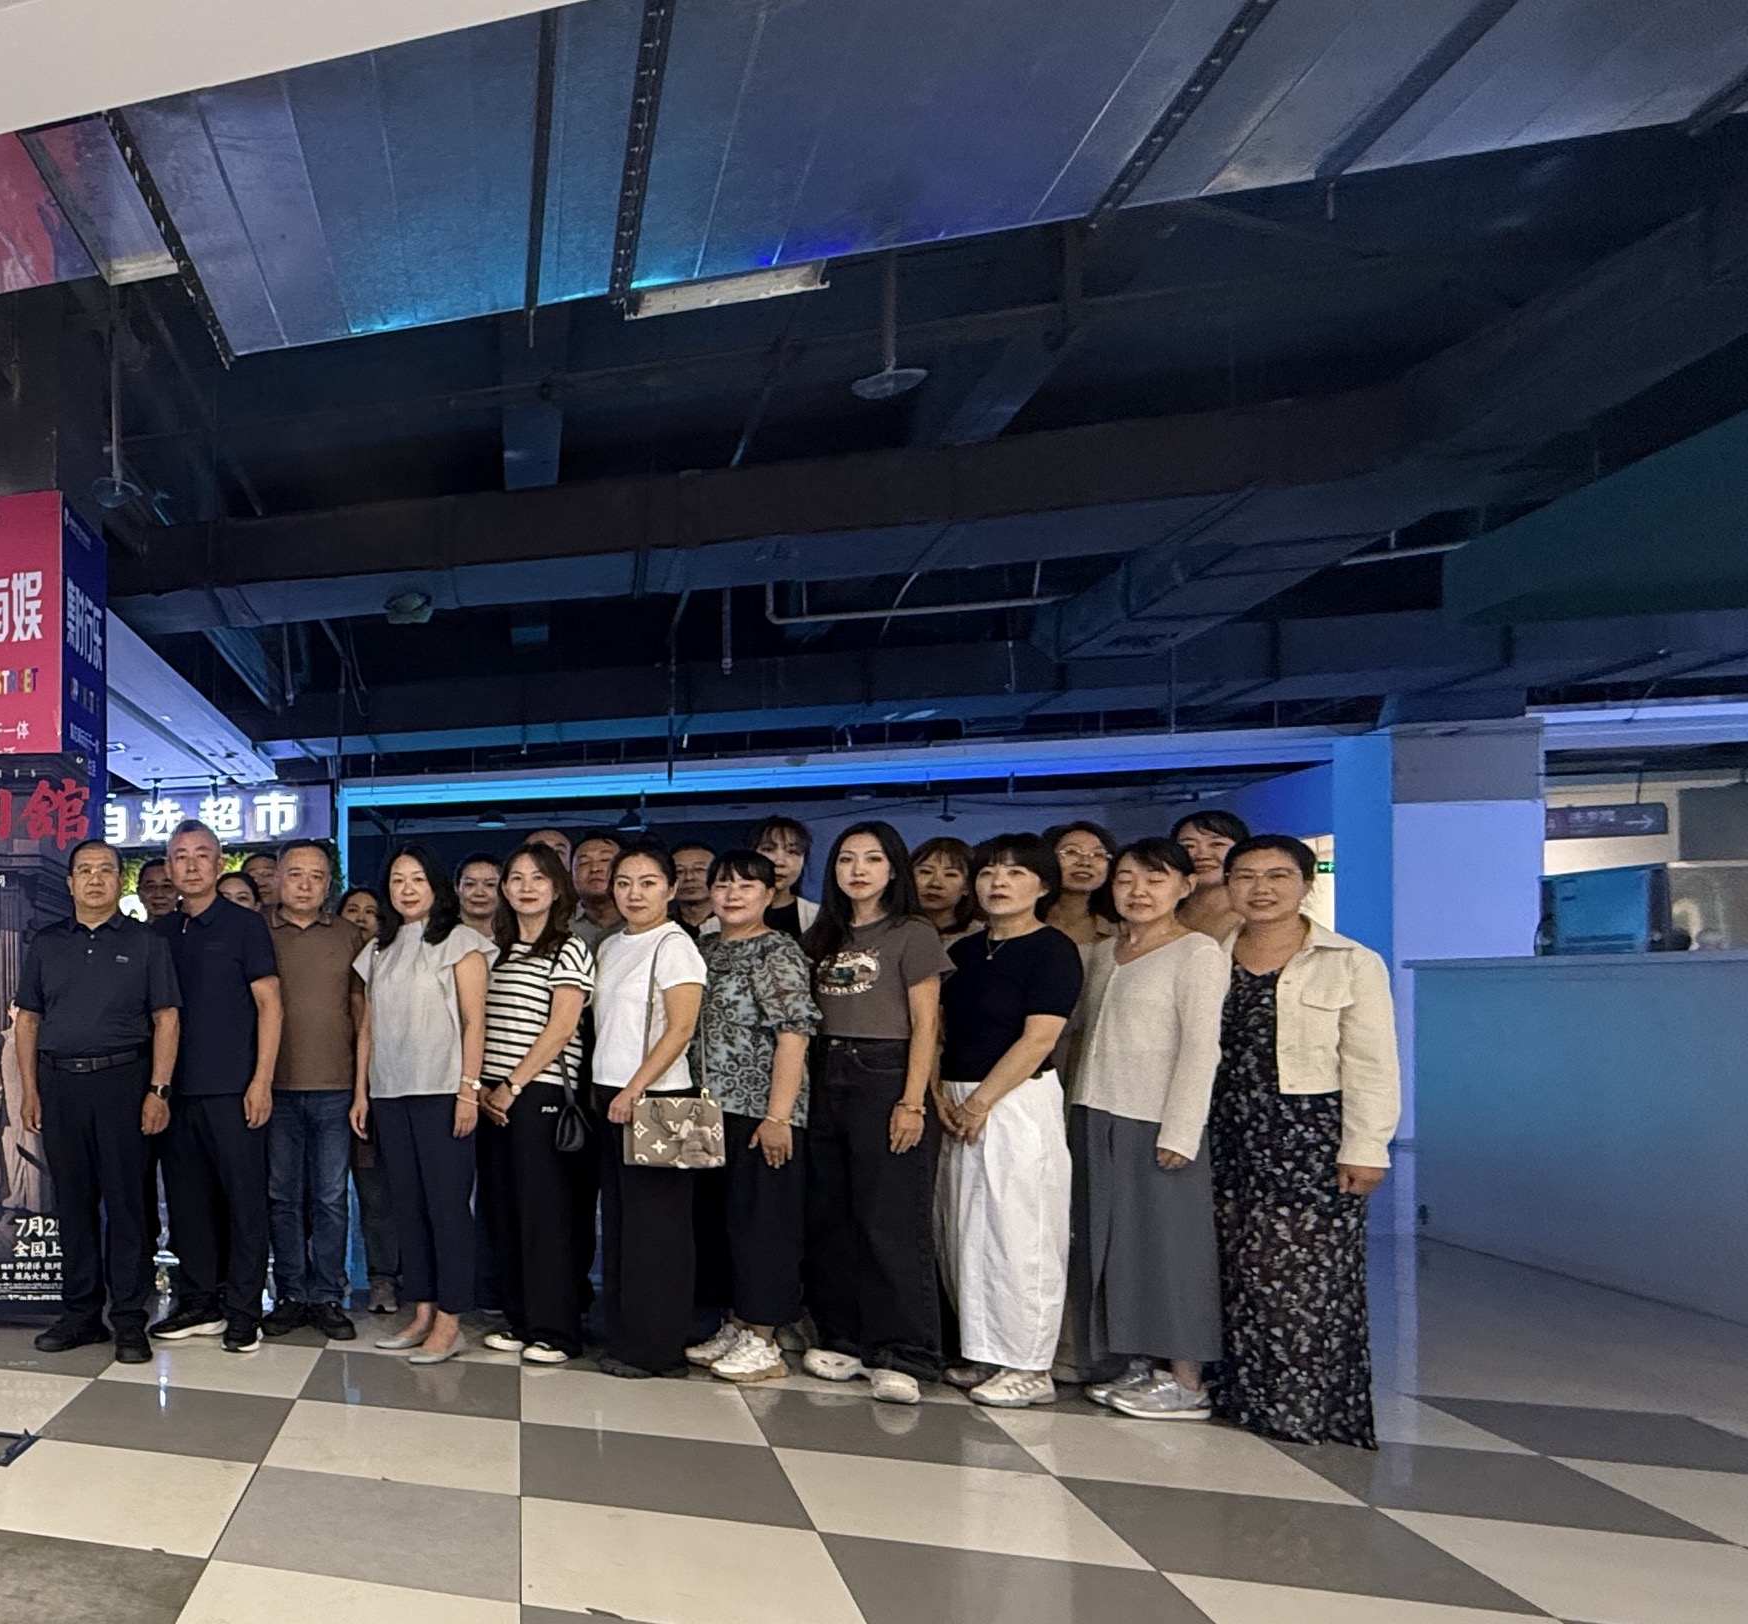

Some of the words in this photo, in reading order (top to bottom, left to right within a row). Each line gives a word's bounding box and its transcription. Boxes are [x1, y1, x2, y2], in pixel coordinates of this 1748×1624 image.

[104, 791, 299, 846] 自选超市
[15, 1216, 60, 1237] 7月2
[13, 1240, 64, 1258] 全国上
